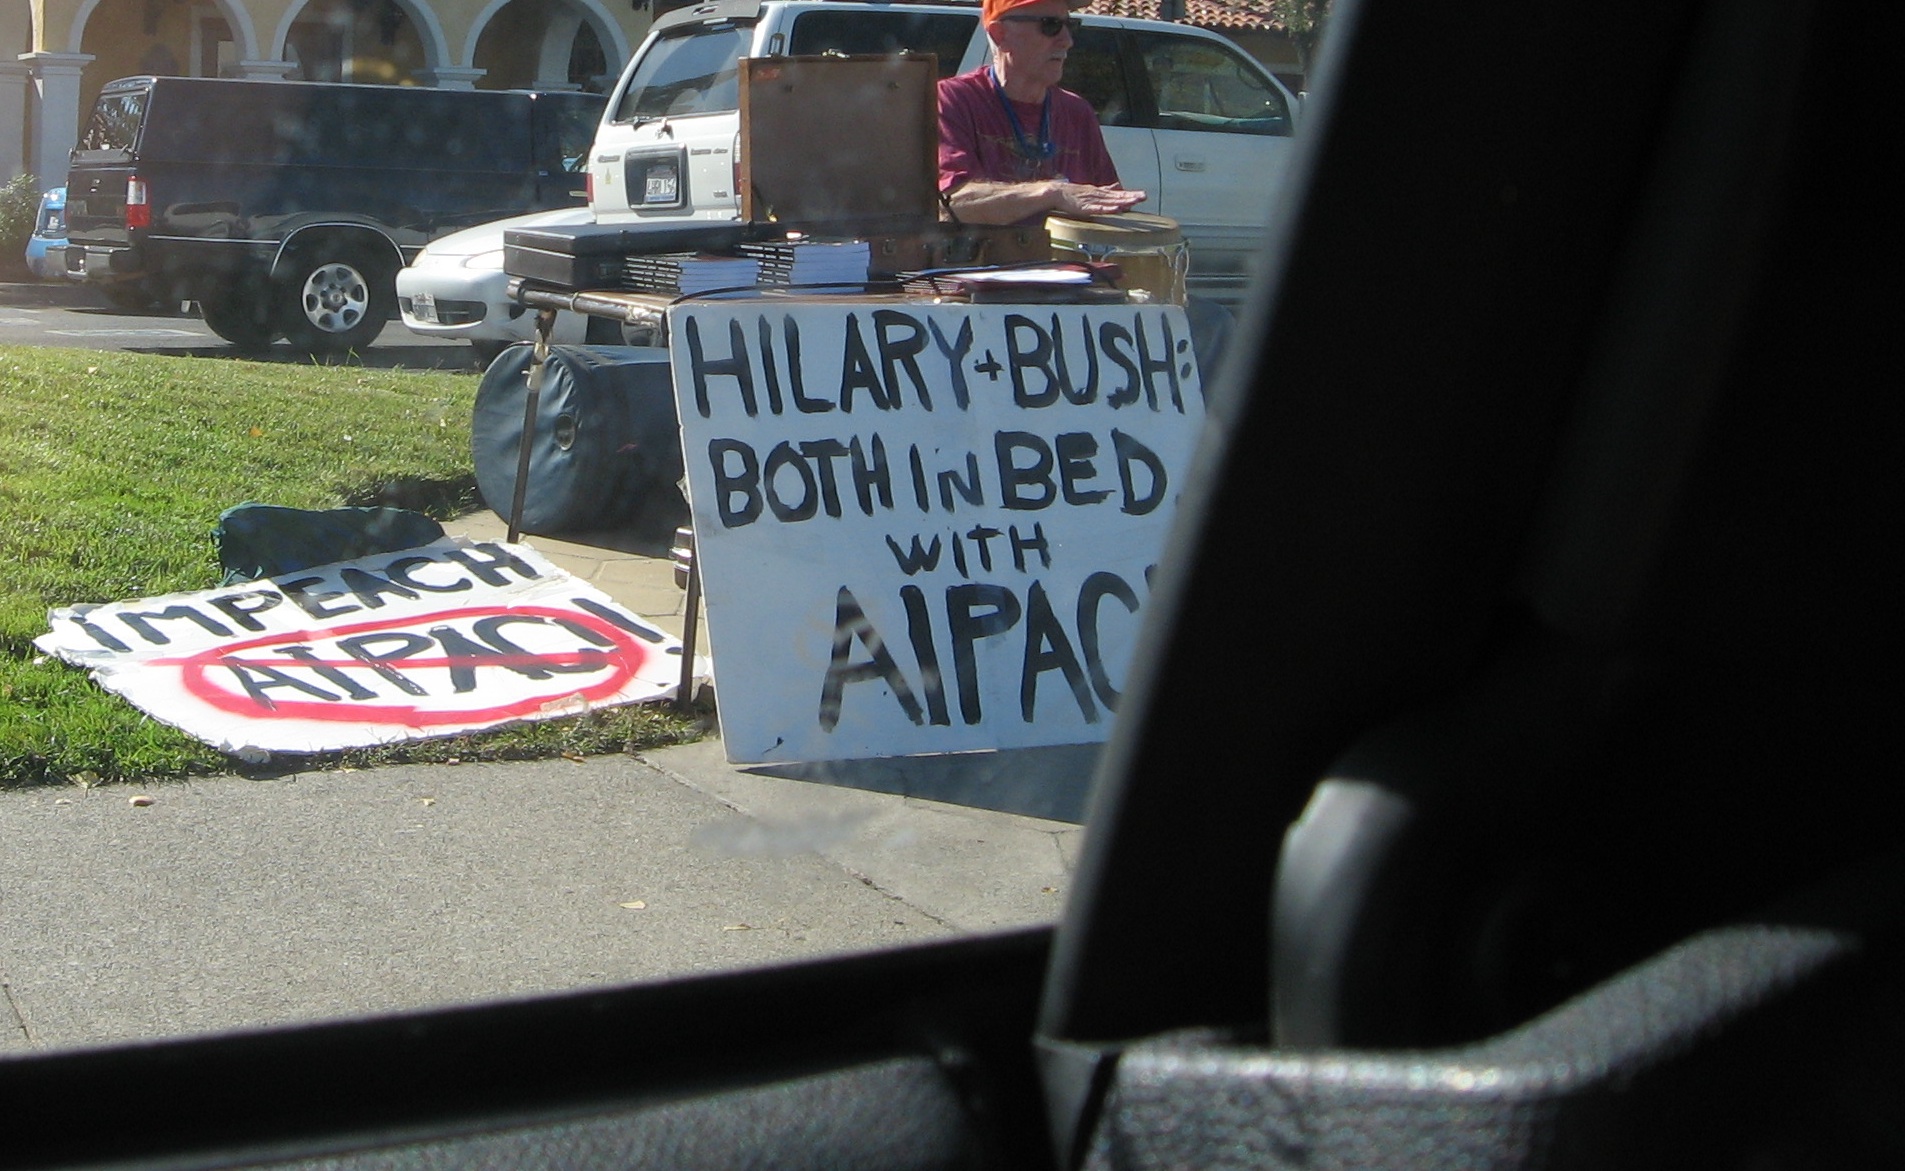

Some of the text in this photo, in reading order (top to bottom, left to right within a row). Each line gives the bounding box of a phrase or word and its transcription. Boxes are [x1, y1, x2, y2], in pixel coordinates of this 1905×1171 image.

[708, 432, 894, 528] BOTH
[68, 542, 542, 654] IMPEACH
[818, 564, 1156, 734] AIPAC
